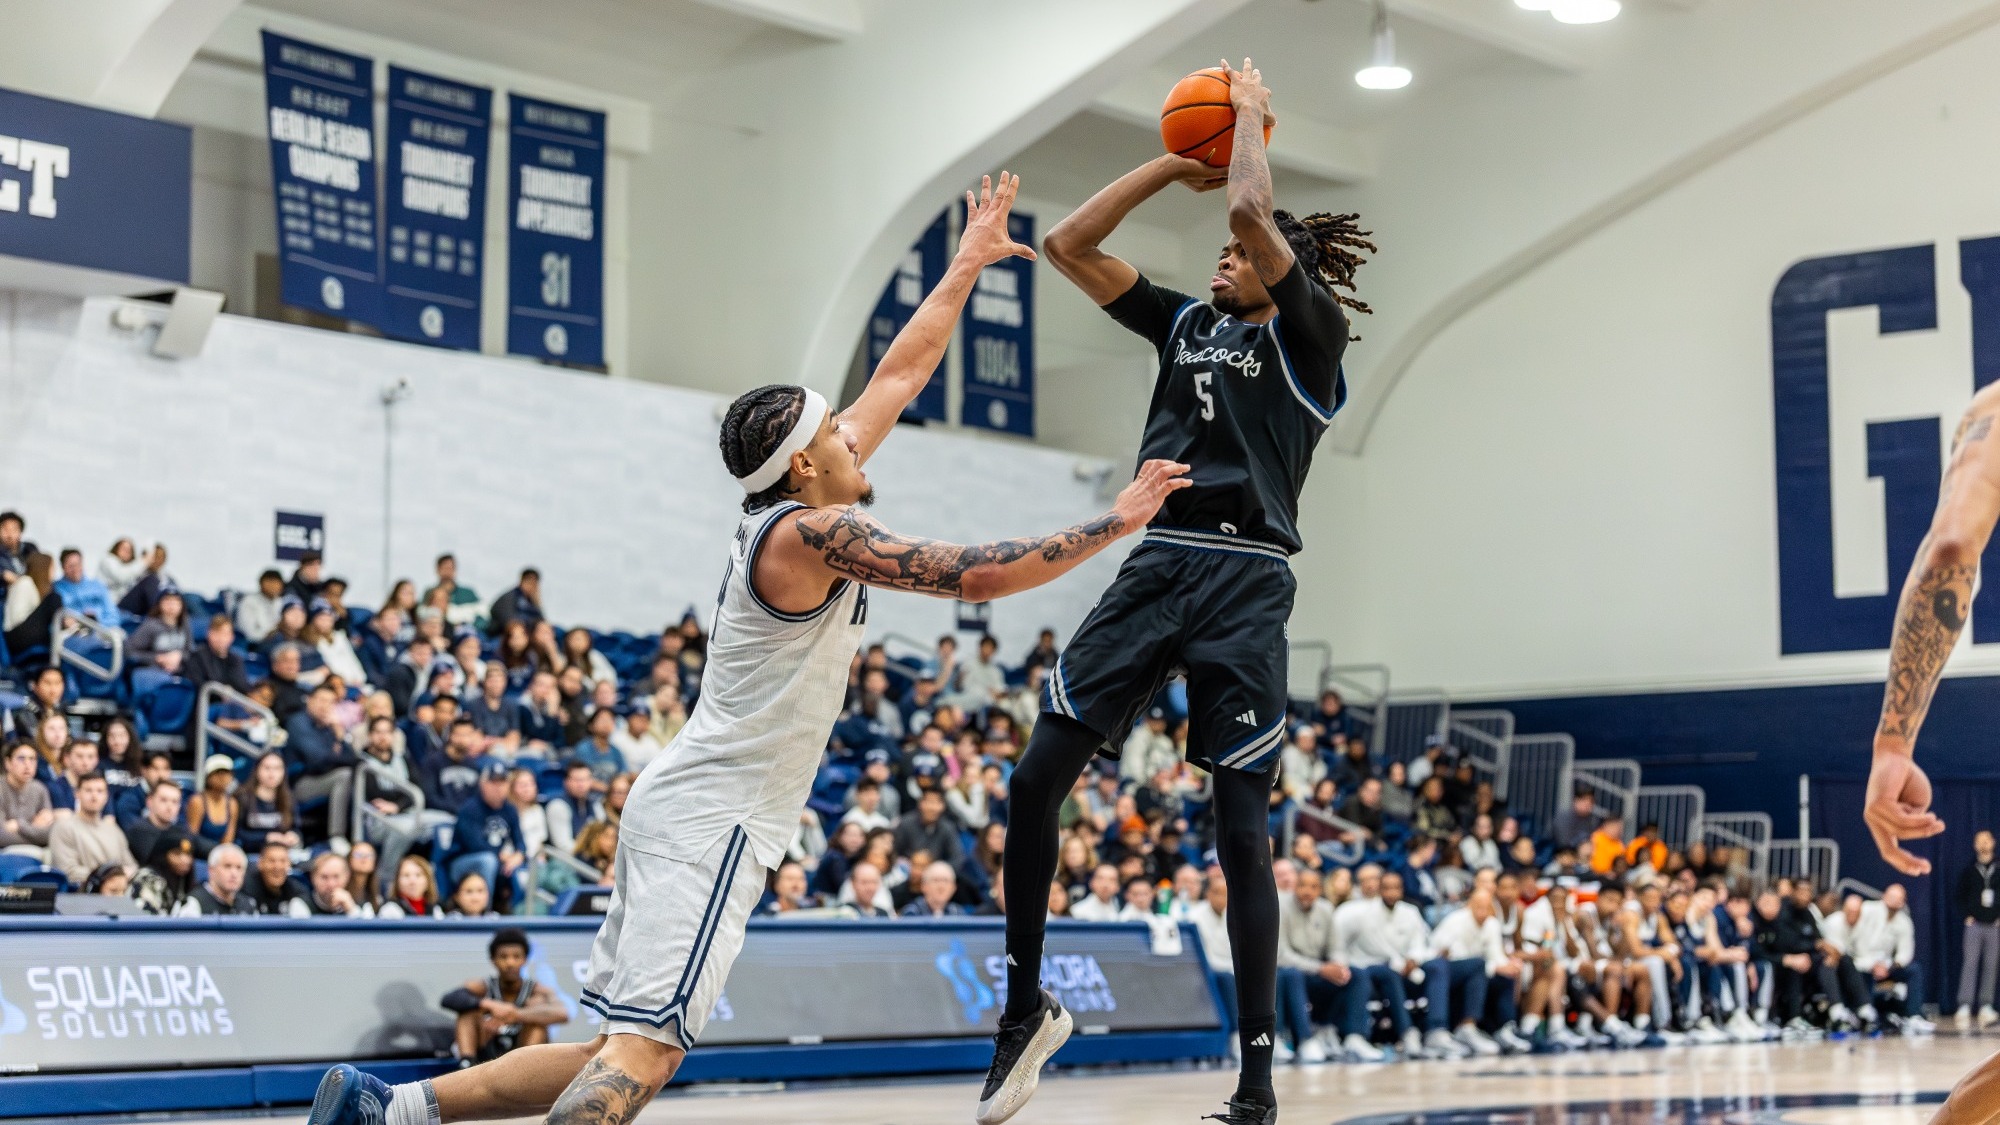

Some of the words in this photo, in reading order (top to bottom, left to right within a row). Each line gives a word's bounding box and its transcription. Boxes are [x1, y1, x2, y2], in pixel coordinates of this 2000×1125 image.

[1193, 371, 1215, 422] 5
[27, 964, 225, 1015] SQUADRA
[37, 1008, 234, 1040] SOLUTIONS
